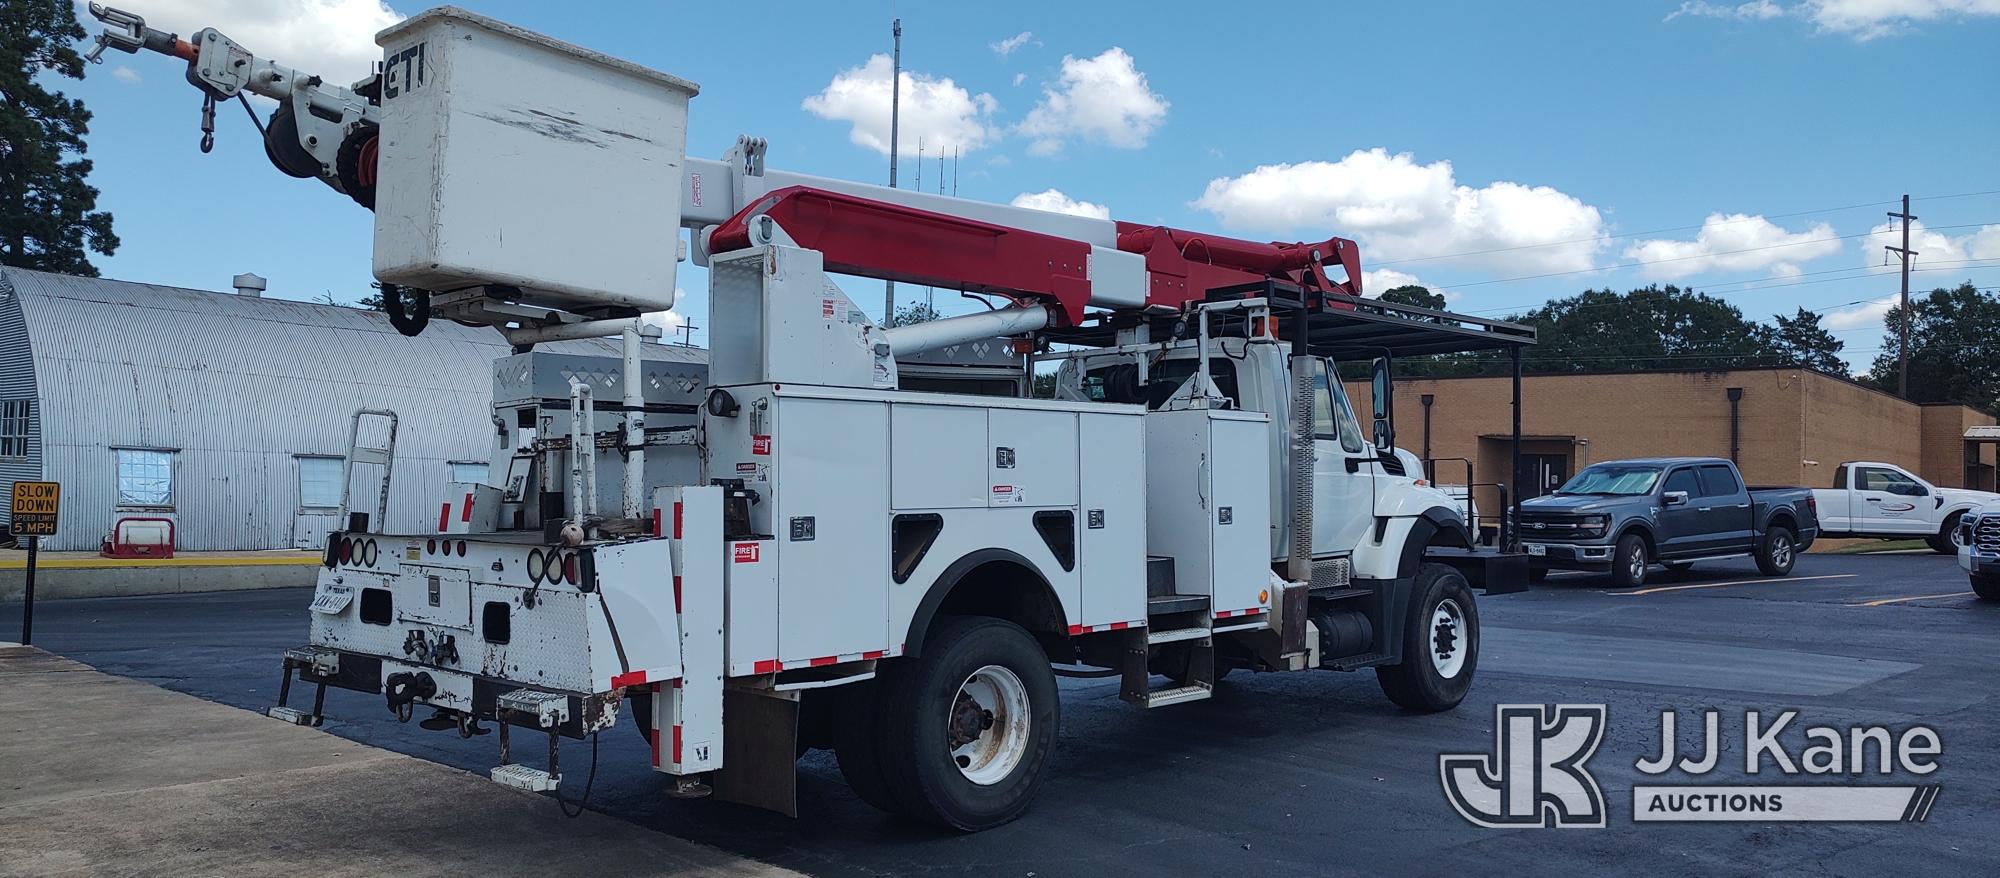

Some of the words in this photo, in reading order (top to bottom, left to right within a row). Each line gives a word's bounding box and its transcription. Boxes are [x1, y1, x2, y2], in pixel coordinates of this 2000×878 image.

[18, 485, 54, 497] SLOW
[17, 499, 54, 511] DOWN
[15, 523, 22, 533] 5
[27, 523, 54, 533] MPH
[735, 546, 751, 555] FIRE
